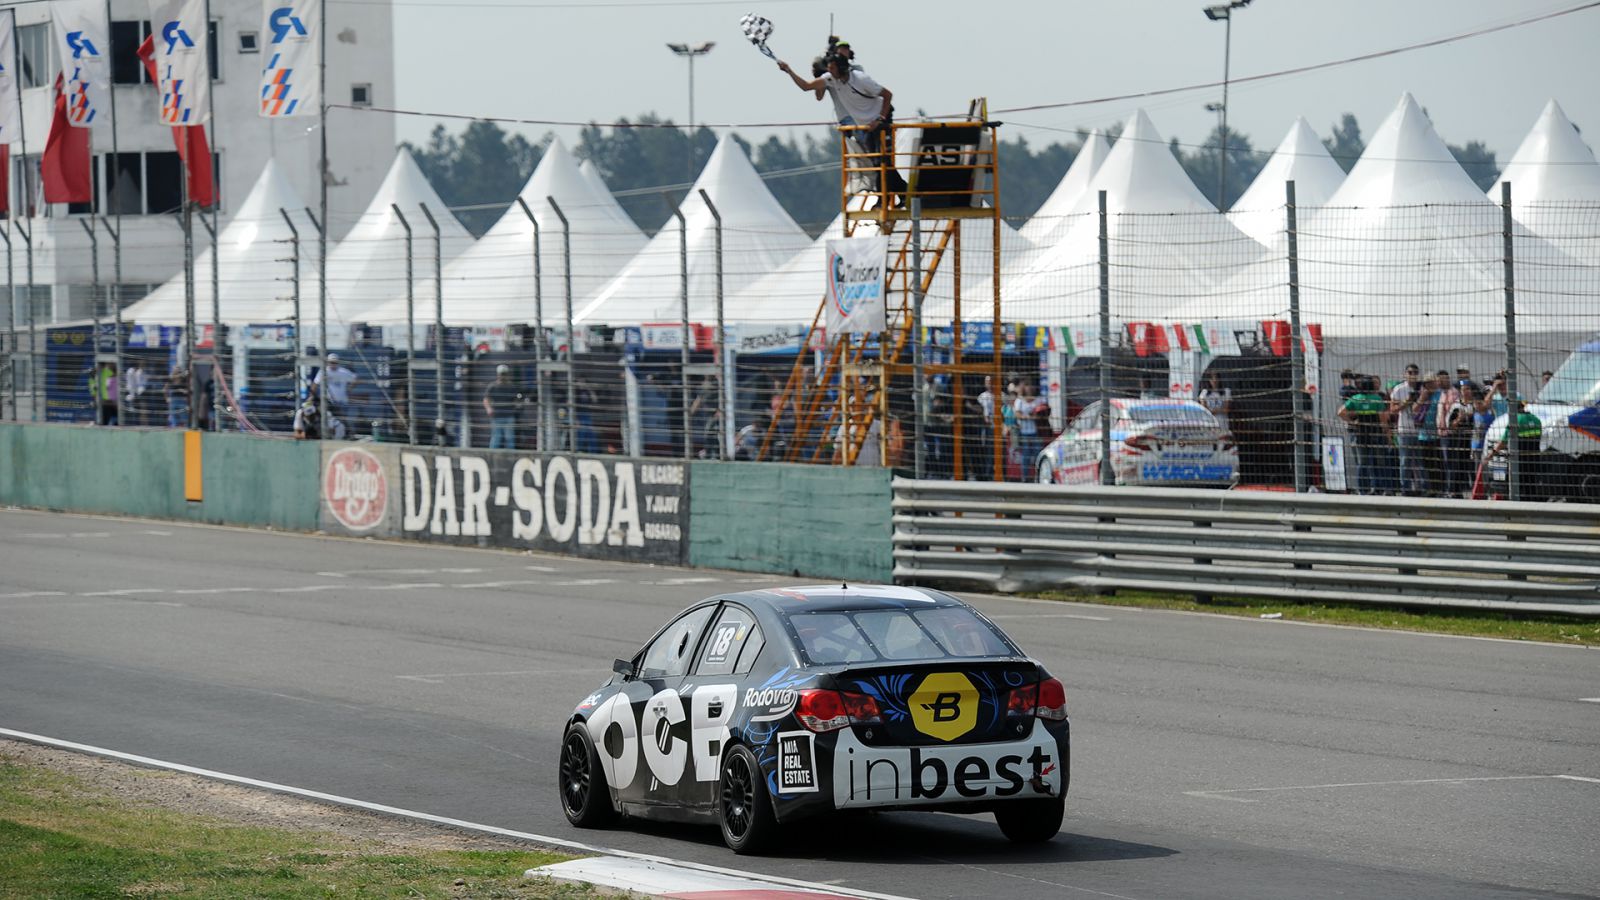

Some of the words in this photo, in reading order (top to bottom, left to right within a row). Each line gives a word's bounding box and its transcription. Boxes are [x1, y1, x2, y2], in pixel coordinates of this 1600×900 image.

[401, 453, 645, 547] DAR-SODA
[644, 522, 681, 541] ROSARIO
[710, 627, 736, 656] 18
[784, 740, 799, 755] MIA
[784, 755, 802, 769] REAL
[784, 770, 811, 785] ESTATE
[848, 746, 1052, 801] inbest
